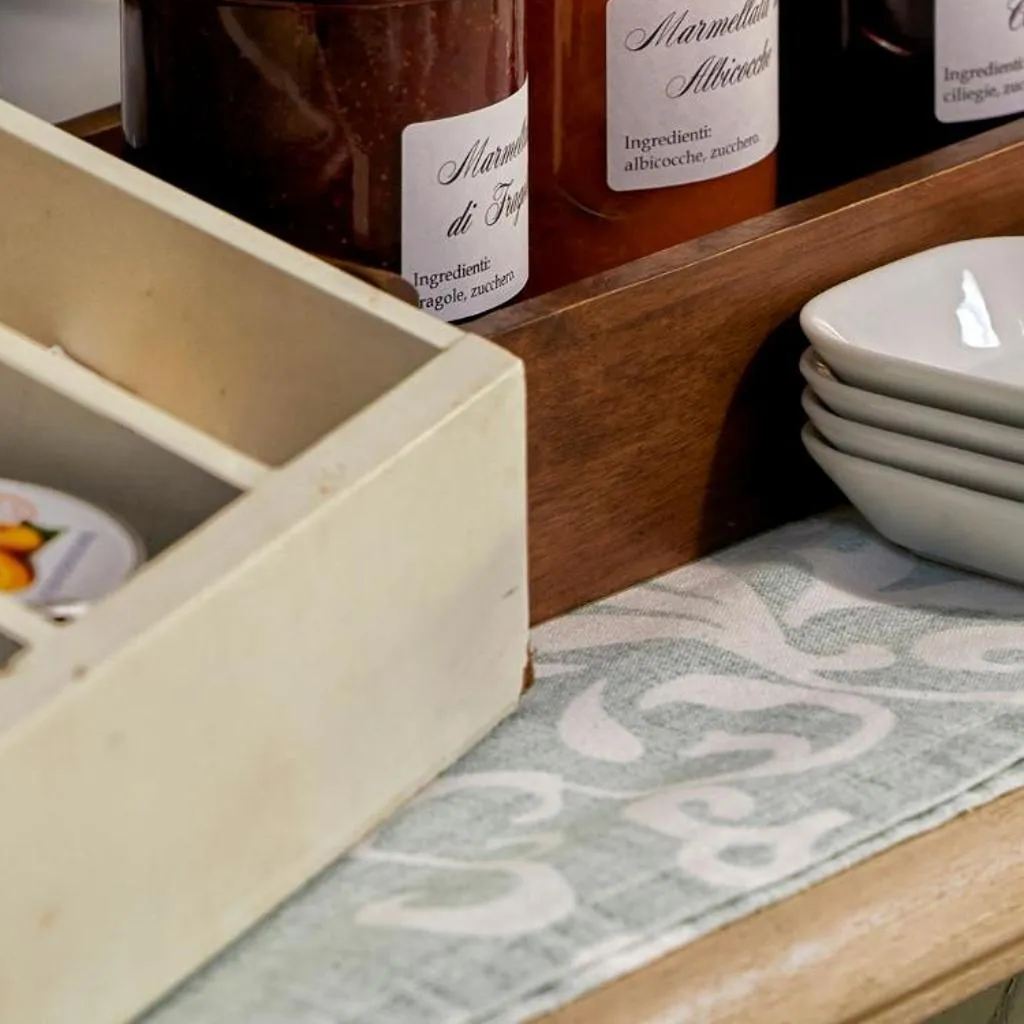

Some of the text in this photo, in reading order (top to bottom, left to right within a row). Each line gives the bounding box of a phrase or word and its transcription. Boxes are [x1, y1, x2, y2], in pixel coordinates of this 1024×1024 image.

[665, 37, 772, 99] Albicocche
[943, 56, 1024, 85] Ingredienti
[624, 124, 713, 153] Ingredienti:
[623, 149, 707, 172] albicocche,
[446, 178, 527, 238] di Frag
[413, 256, 492, 289] Ingredienti:
[417, 287, 467, 311] ragole,
